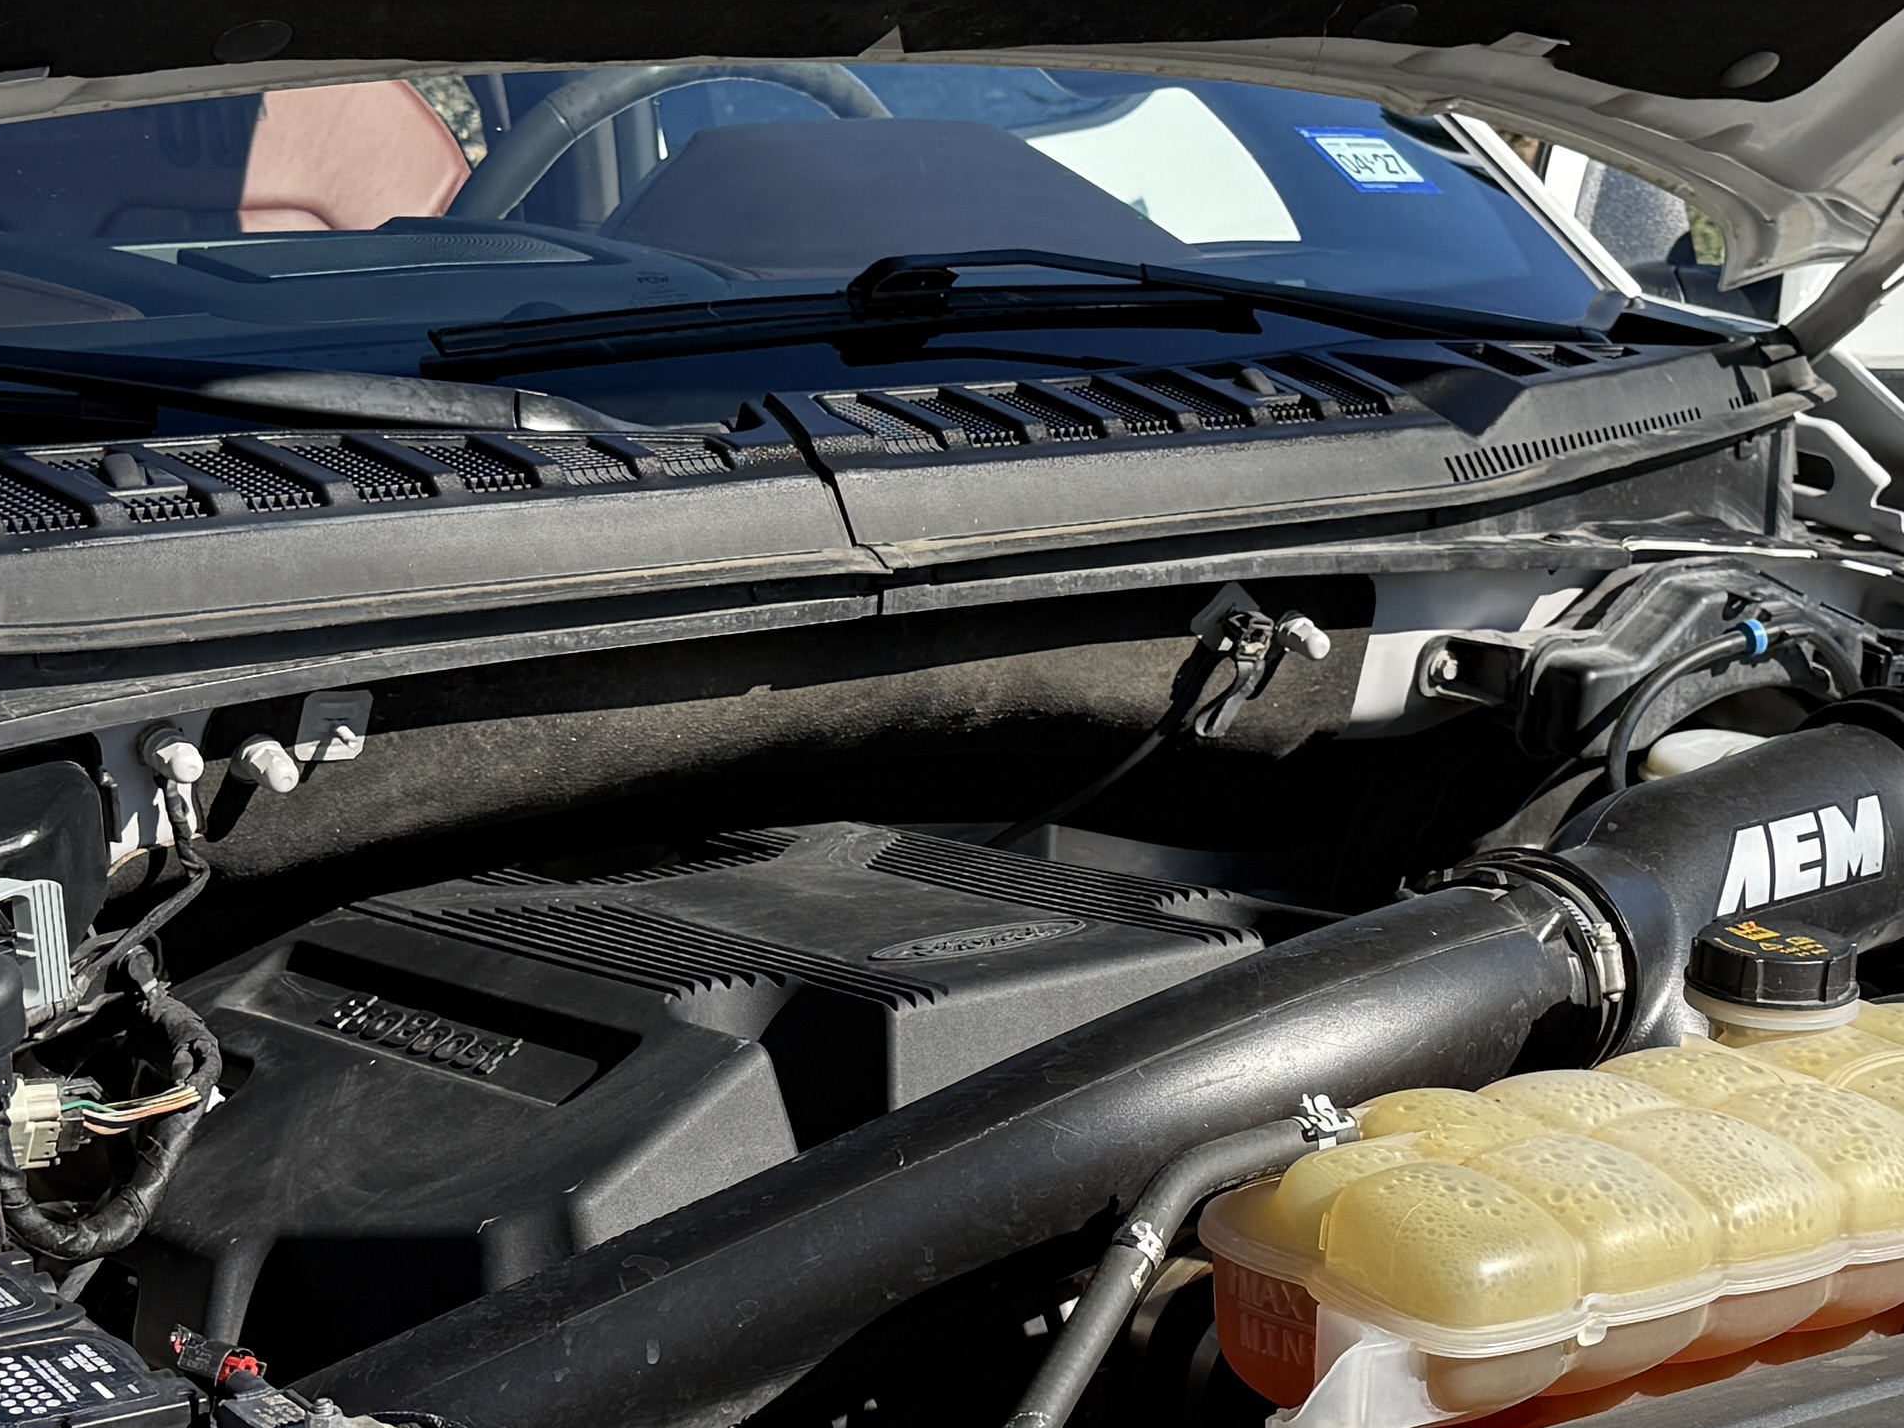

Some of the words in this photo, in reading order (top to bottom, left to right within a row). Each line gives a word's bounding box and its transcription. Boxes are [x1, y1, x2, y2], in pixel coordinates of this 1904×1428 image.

[1716, 794, 1886, 917] AEM
[1238, 1268, 1308, 1321] MAX
[1239, 1313, 1307, 1365] MIN
